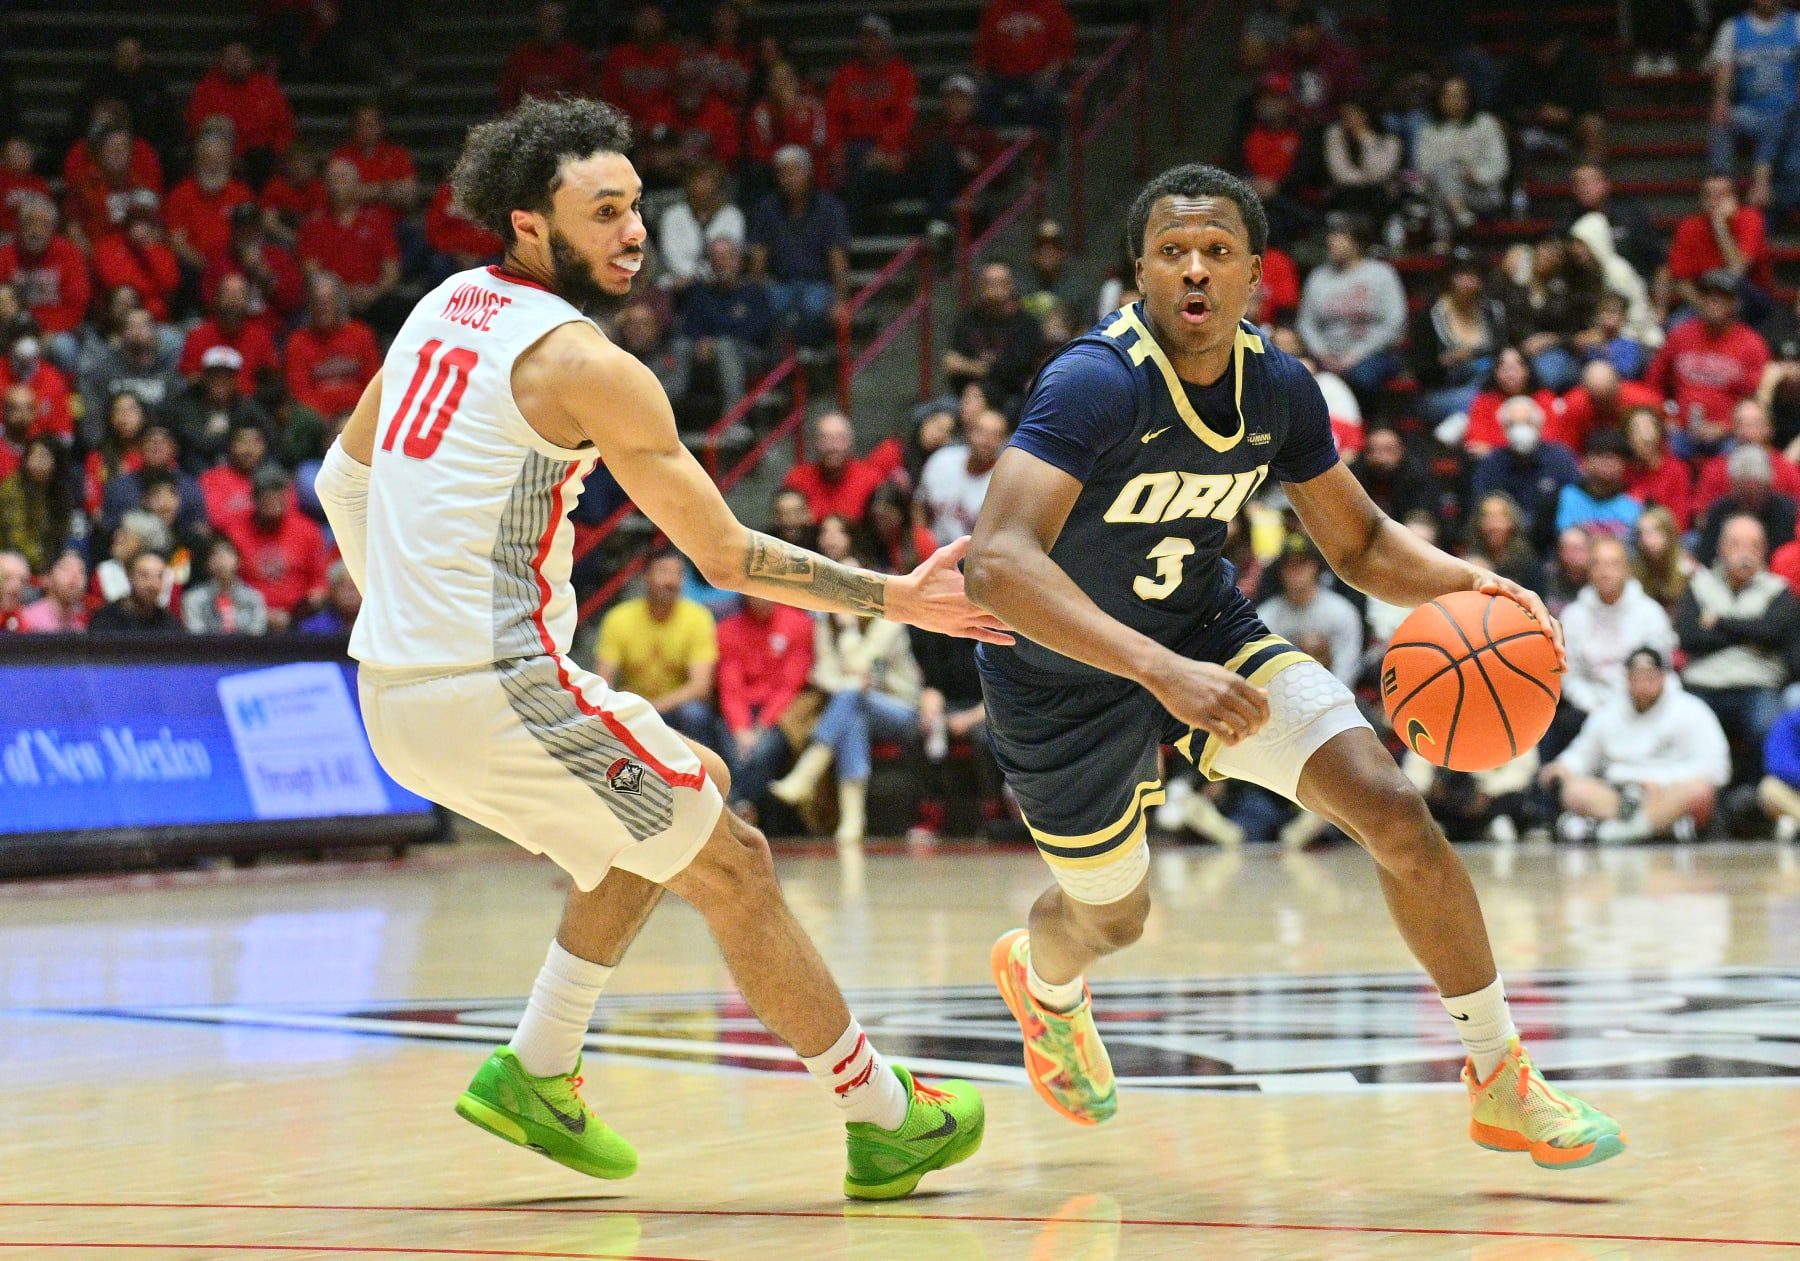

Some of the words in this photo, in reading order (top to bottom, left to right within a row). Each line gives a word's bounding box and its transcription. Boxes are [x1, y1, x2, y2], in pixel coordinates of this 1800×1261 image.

[440, 282, 512, 332] HOUSE
[381, 338, 480, 460] 10
[1132, 536, 1196, 600] 3
[3, 729, 41, 786] of
[33, 729, 106, 786] New
[100, 725, 213, 783] Mexico
